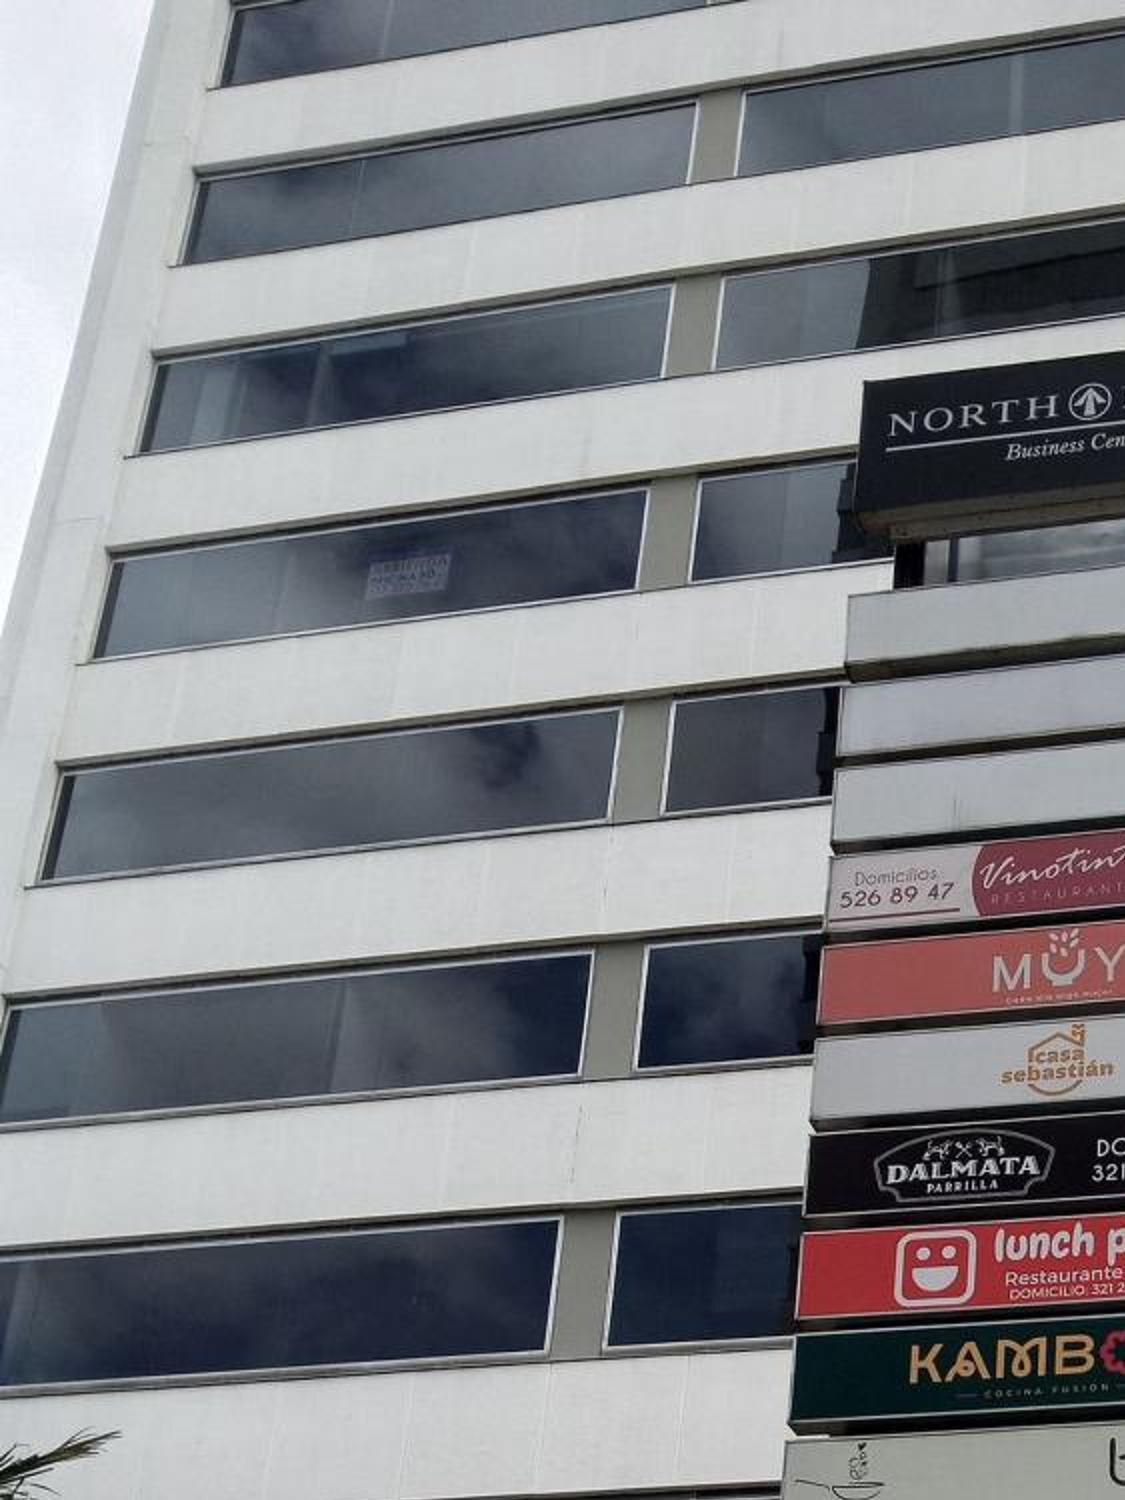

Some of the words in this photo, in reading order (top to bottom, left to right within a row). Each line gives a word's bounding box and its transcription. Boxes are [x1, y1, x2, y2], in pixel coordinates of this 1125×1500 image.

[887, 394, 1058, 437] NORTH
[1006, 440, 1085, 462] Business
[840, 889, 881, 908] 526
[890, 885, 918, 904] 89
[928, 881, 955, 900] 47
[1036, 1048, 1085, 1063] casa
[1001, 1059, 1114, 1084] sebastián
[886, 1155, 1041, 1185] DALMATA
[926, 1179, 999, 1194] PARRILLA
[994, 1221, 1095, 1263] lunch
[1004, 1264, 1125, 1287] Restaurante
[1091, 1282, 1114, 1295] 321
